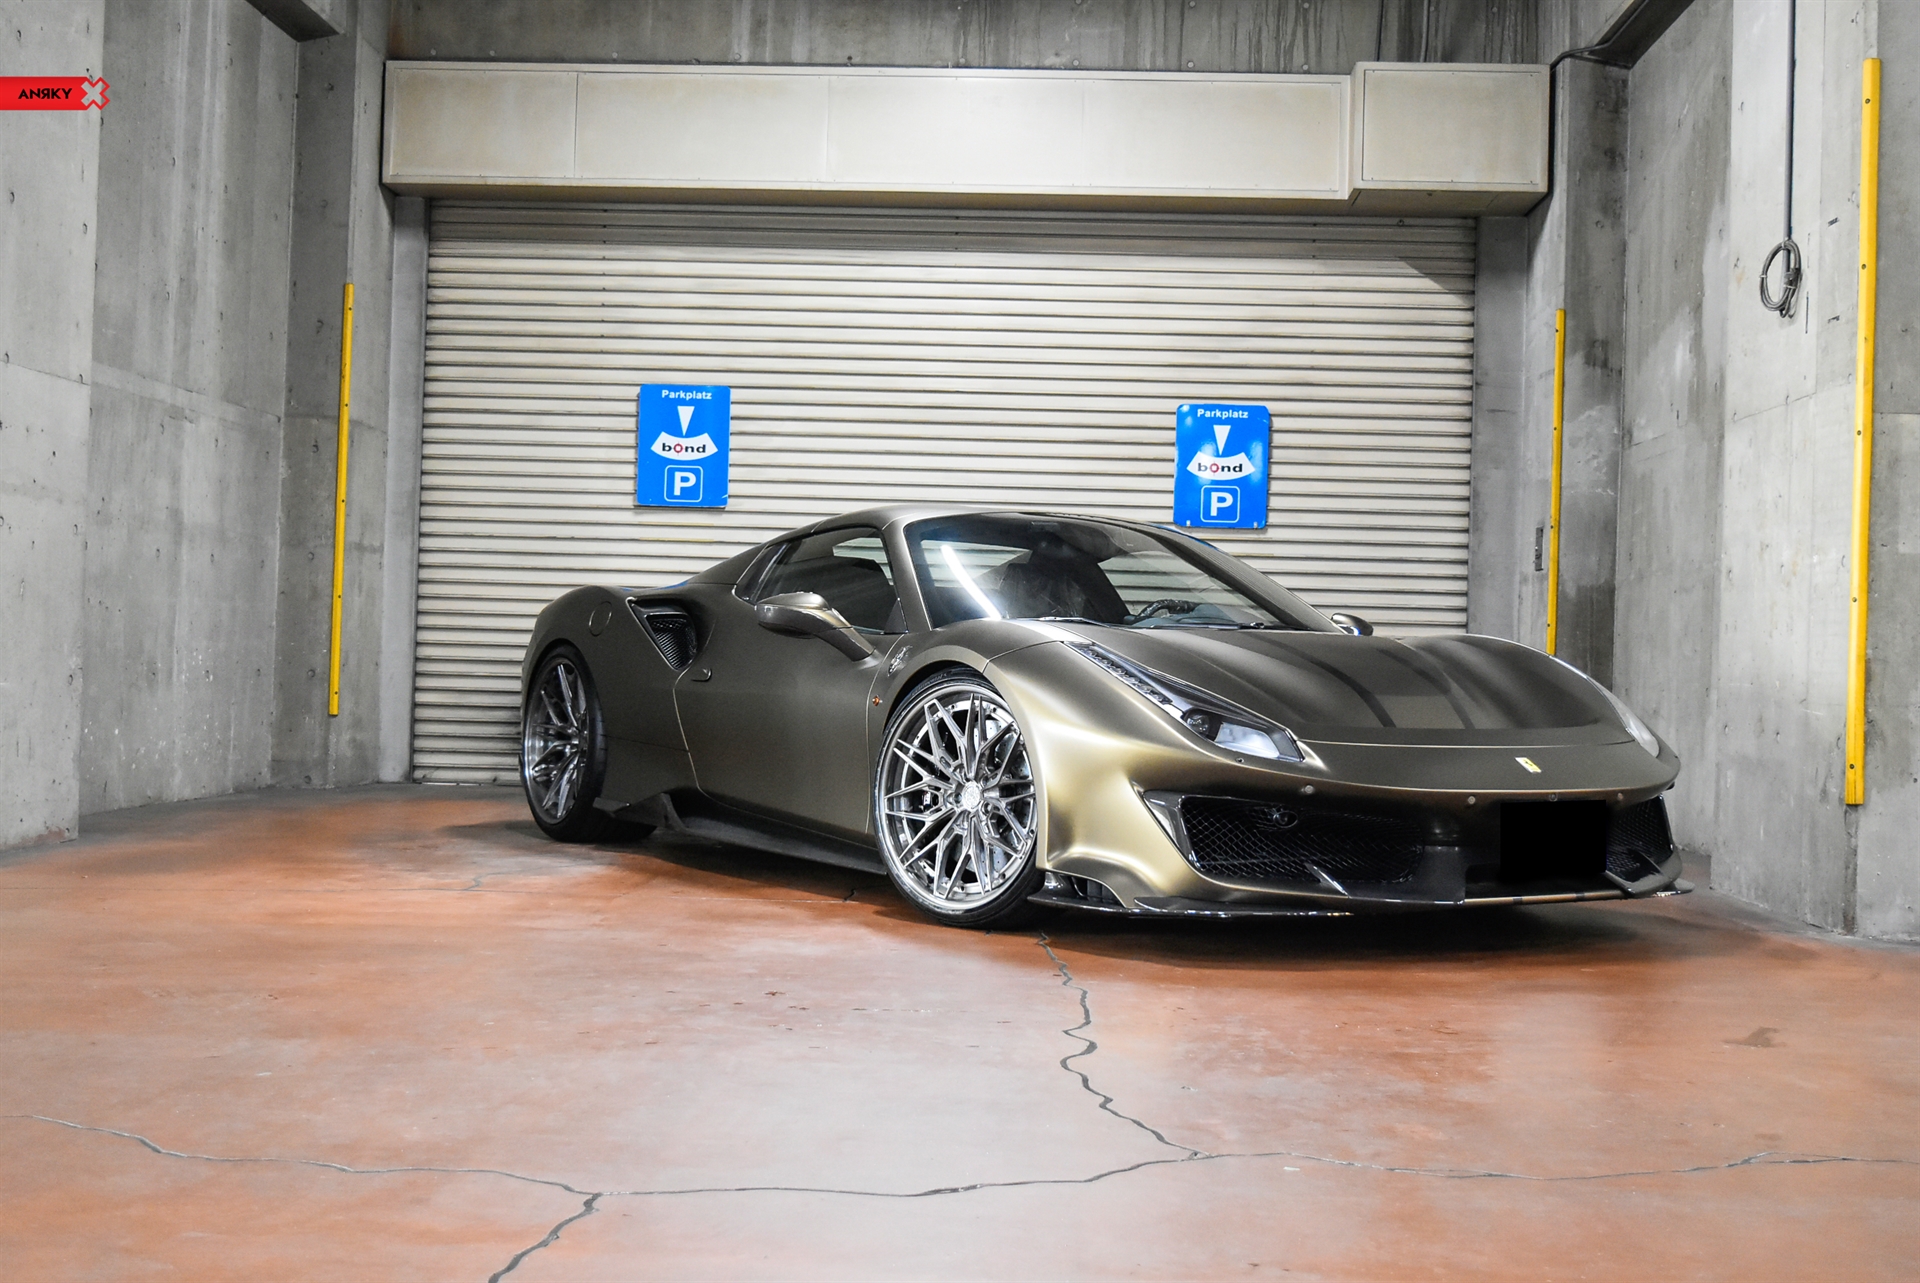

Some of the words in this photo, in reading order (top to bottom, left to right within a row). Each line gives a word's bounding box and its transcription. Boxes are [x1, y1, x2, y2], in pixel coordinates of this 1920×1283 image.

[662, 389, 712, 401] Parkplatz
[1197, 408, 1249, 419] Parkplatz
[662, 442, 706, 453] bond
[1197, 462, 1243, 473] bond
[674, 471, 697, 496] P
[1210, 491, 1234, 517] P
